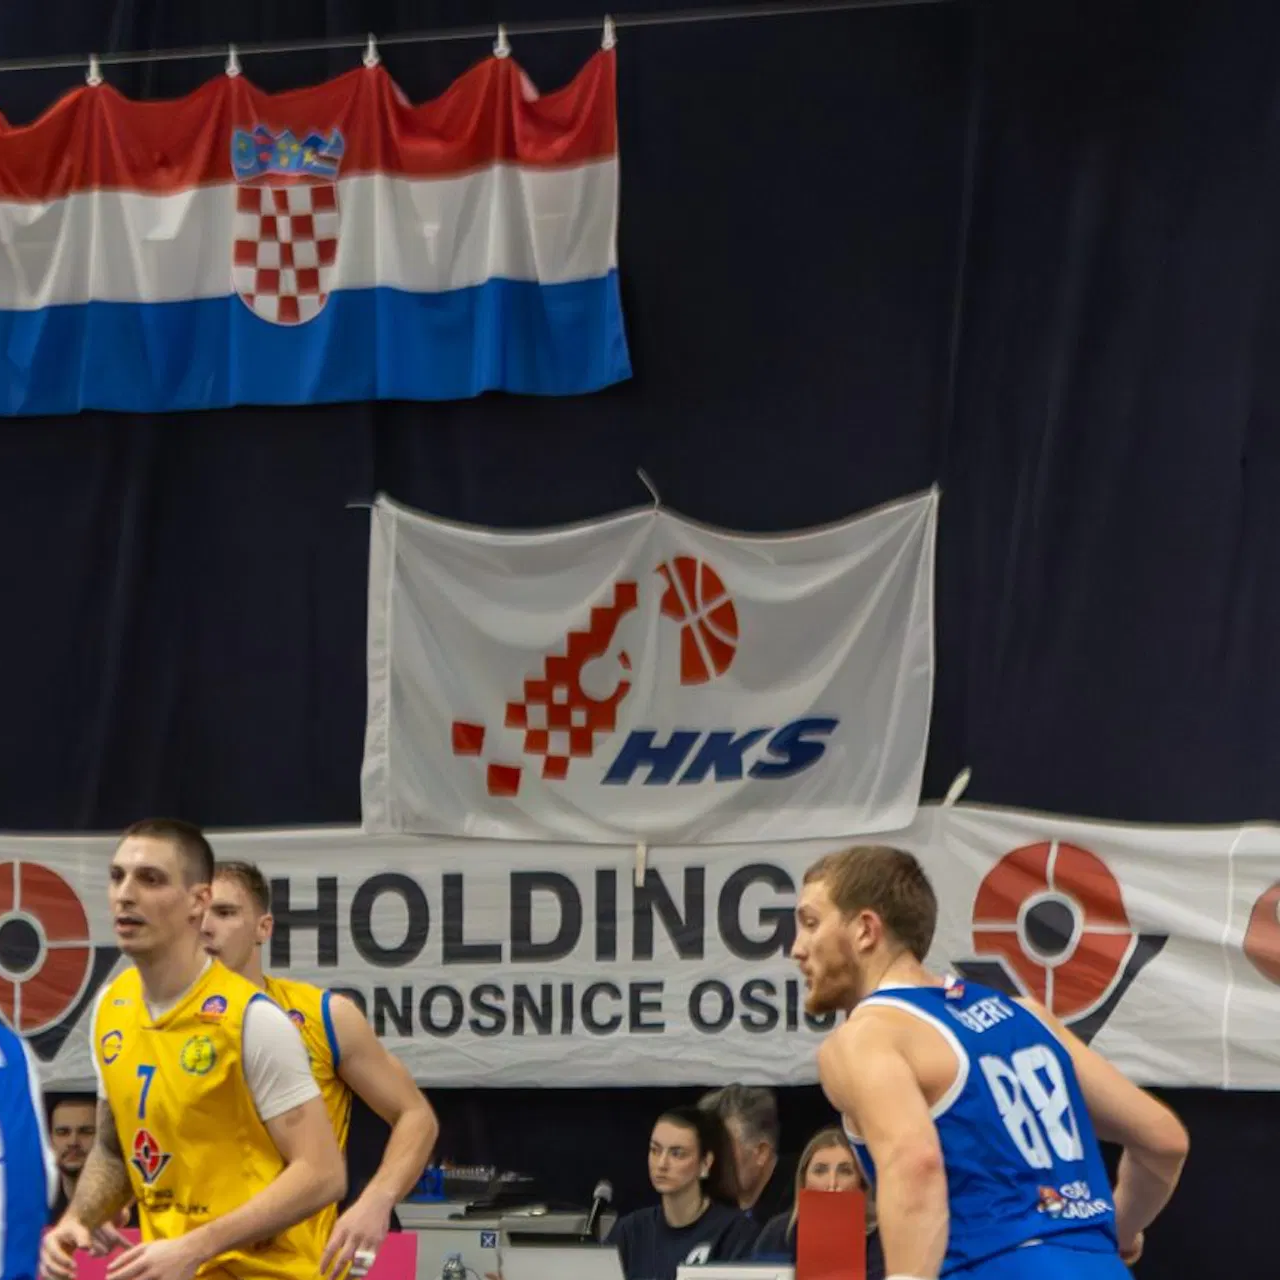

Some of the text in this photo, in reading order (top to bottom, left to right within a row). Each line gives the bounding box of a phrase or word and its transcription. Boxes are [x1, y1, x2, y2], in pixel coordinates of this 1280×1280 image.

[600, 717, 839, 786] HKS
[270, 863, 798, 969] HOLDING
[328, 977, 836, 1037] NOSNICE OSI
[136, 1065, 157, 1119] 7
[979, 1045, 1084, 1169] 88
